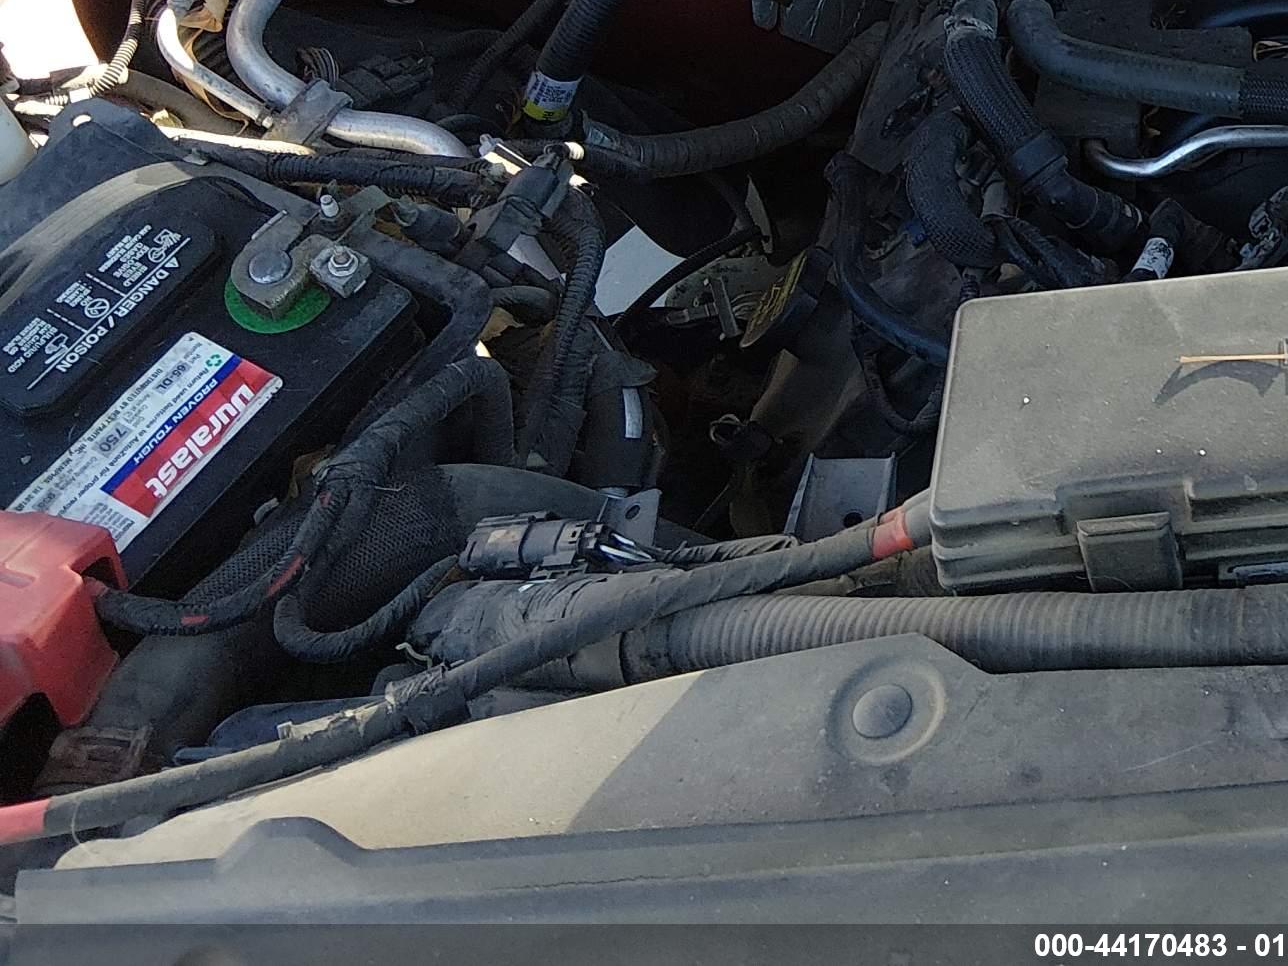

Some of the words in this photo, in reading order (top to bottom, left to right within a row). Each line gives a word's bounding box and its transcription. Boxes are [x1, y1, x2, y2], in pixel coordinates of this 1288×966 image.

[113, 268, 169, 318] DANGER
[55, 326, 108, 372] POISON
[155, 363, 186, 392] 65-DL
[171, 378, 218, 424] PROVEN
[97, 426, 127, 453] 750
[109, 436, 139, 466] AutoZone
[133, 423, 173, 465] TOUGH
